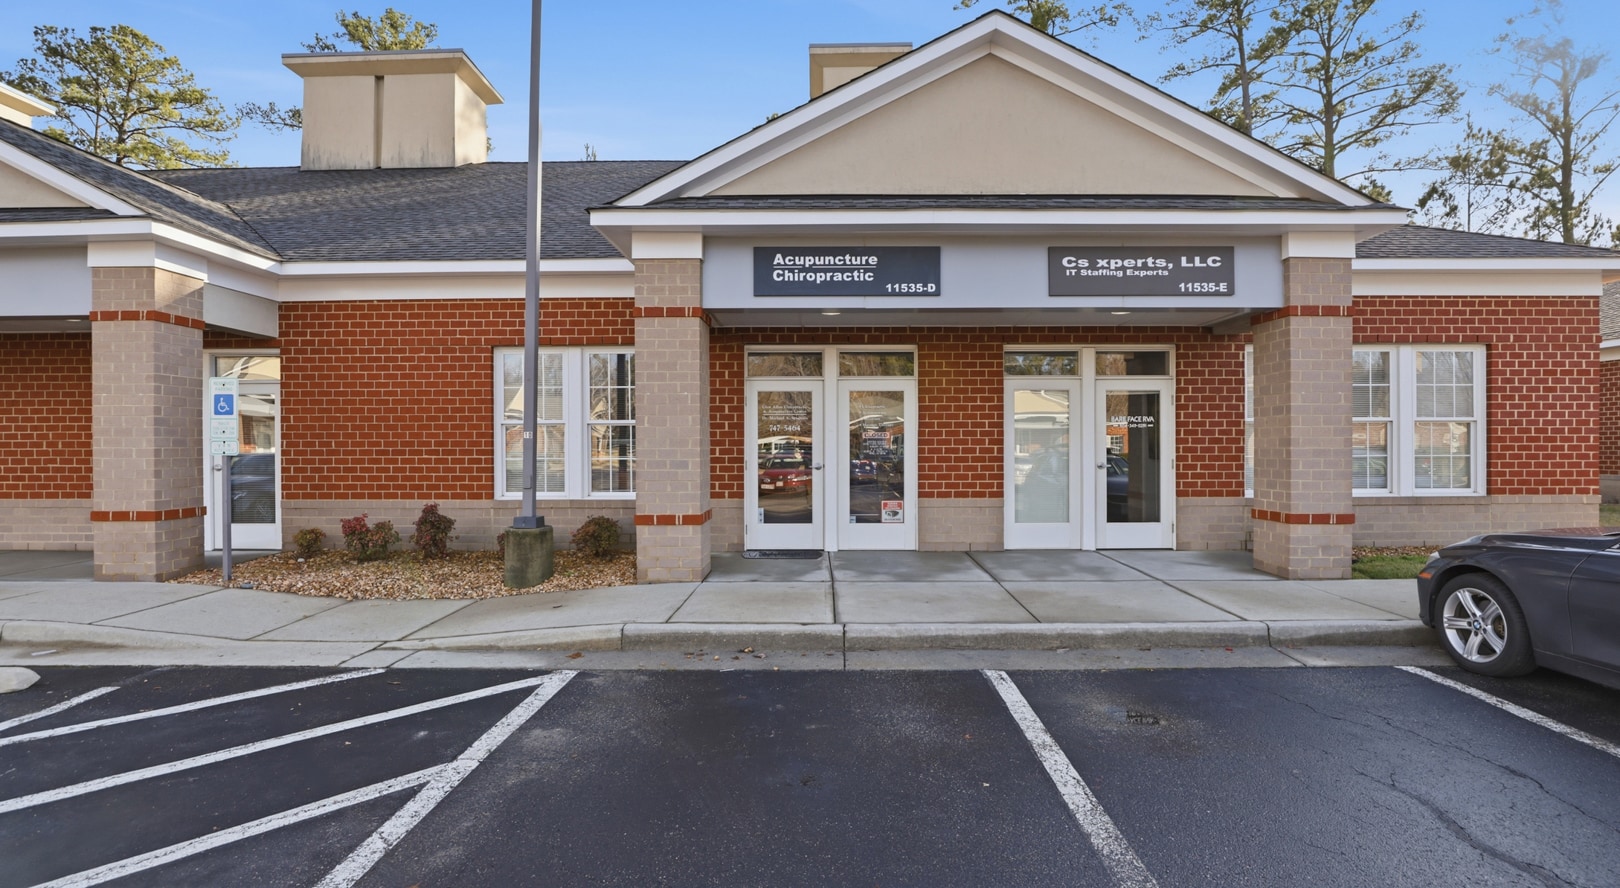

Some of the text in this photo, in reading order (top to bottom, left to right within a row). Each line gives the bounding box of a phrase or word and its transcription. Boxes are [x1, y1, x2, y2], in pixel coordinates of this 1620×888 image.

[773, 253, 878, 267] Acupuncture
[1061, 256, 1222, 270] Cs xperts, LLC
[772, 269, 875, 283] Chiropractic
[1080, 269, 1124, 277] Staffing
[1126, 269, 1169, 277] Experts
[885, 283, 936, 293] 11535-D
[1178, 282, 1228, 292] 11535-E
